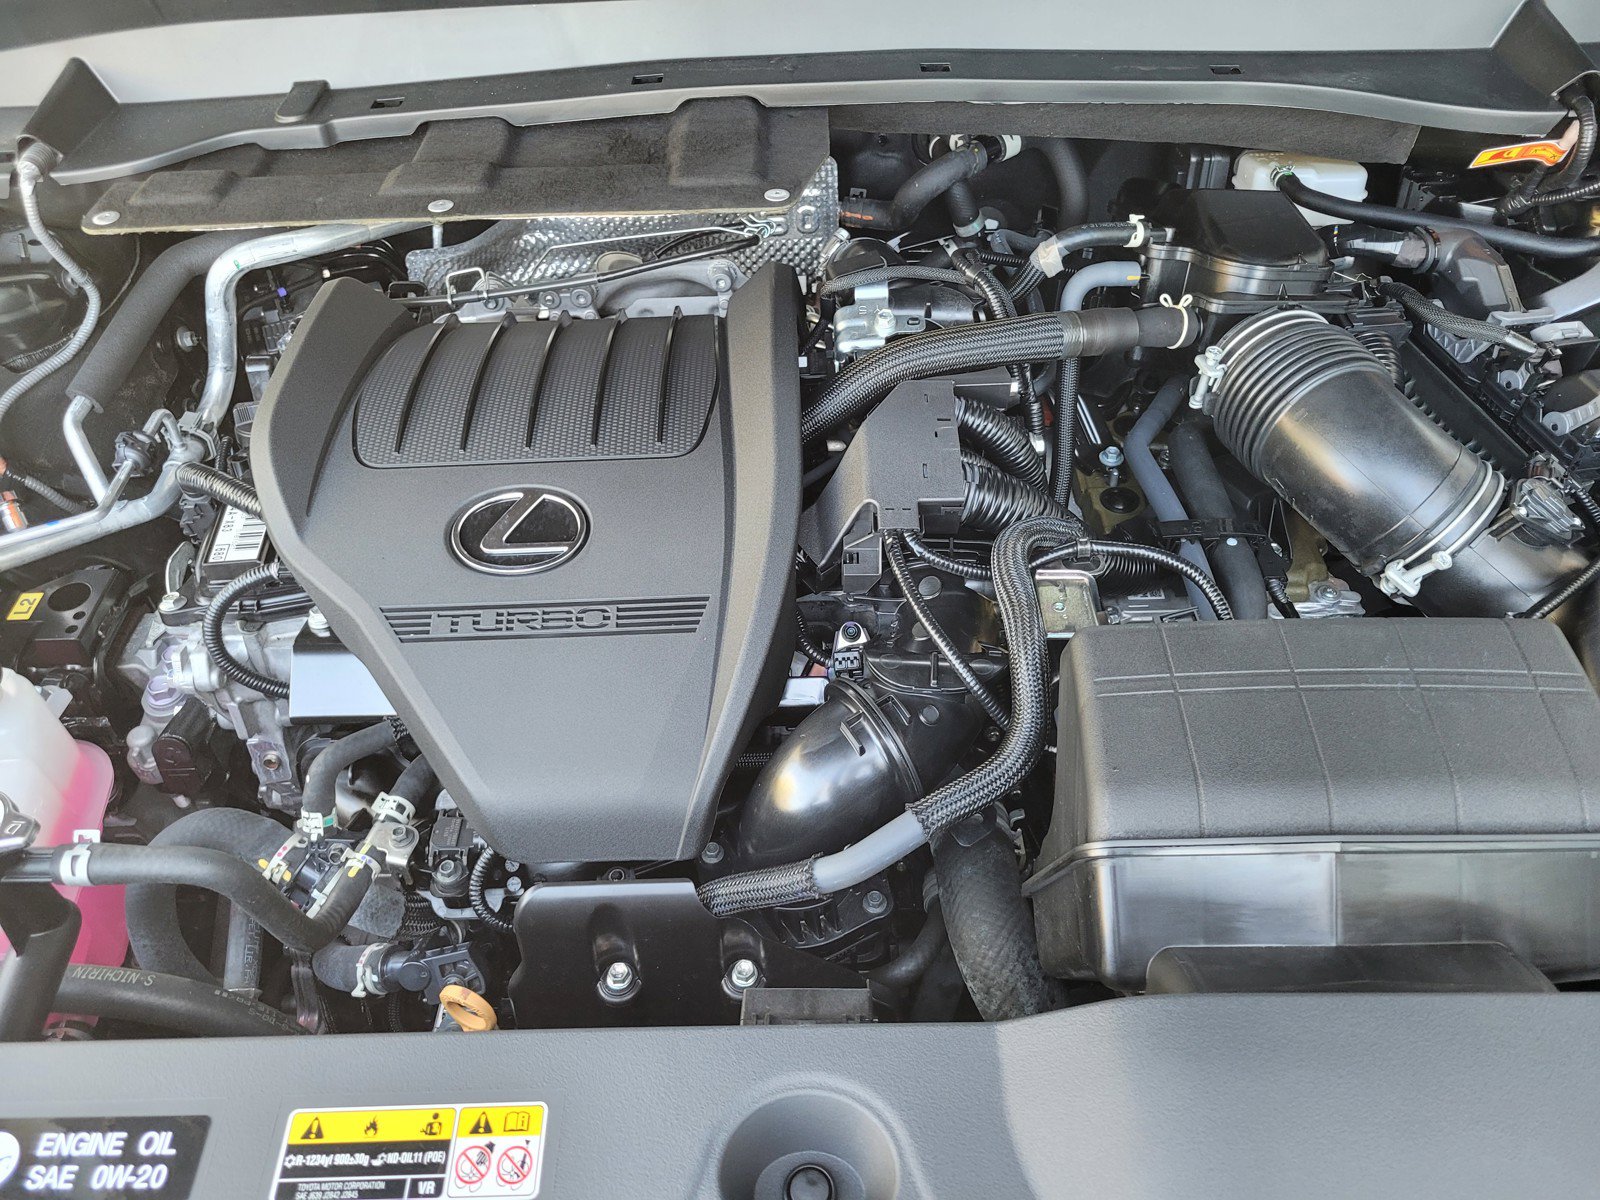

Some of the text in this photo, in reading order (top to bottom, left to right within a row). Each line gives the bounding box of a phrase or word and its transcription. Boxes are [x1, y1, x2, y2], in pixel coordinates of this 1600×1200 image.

[13, 598, 37, 615] L2
[435, 606, 613, 633] TURBO
[35, 1130, 177, 1158] ENGINE OIL
[23, 1163, 169, 1191] SAE 0W-20
[297, 1180, 386, 1192] TOYOTA MOTOR CORPORATION
[417, 1180, 436, 1195] VR
